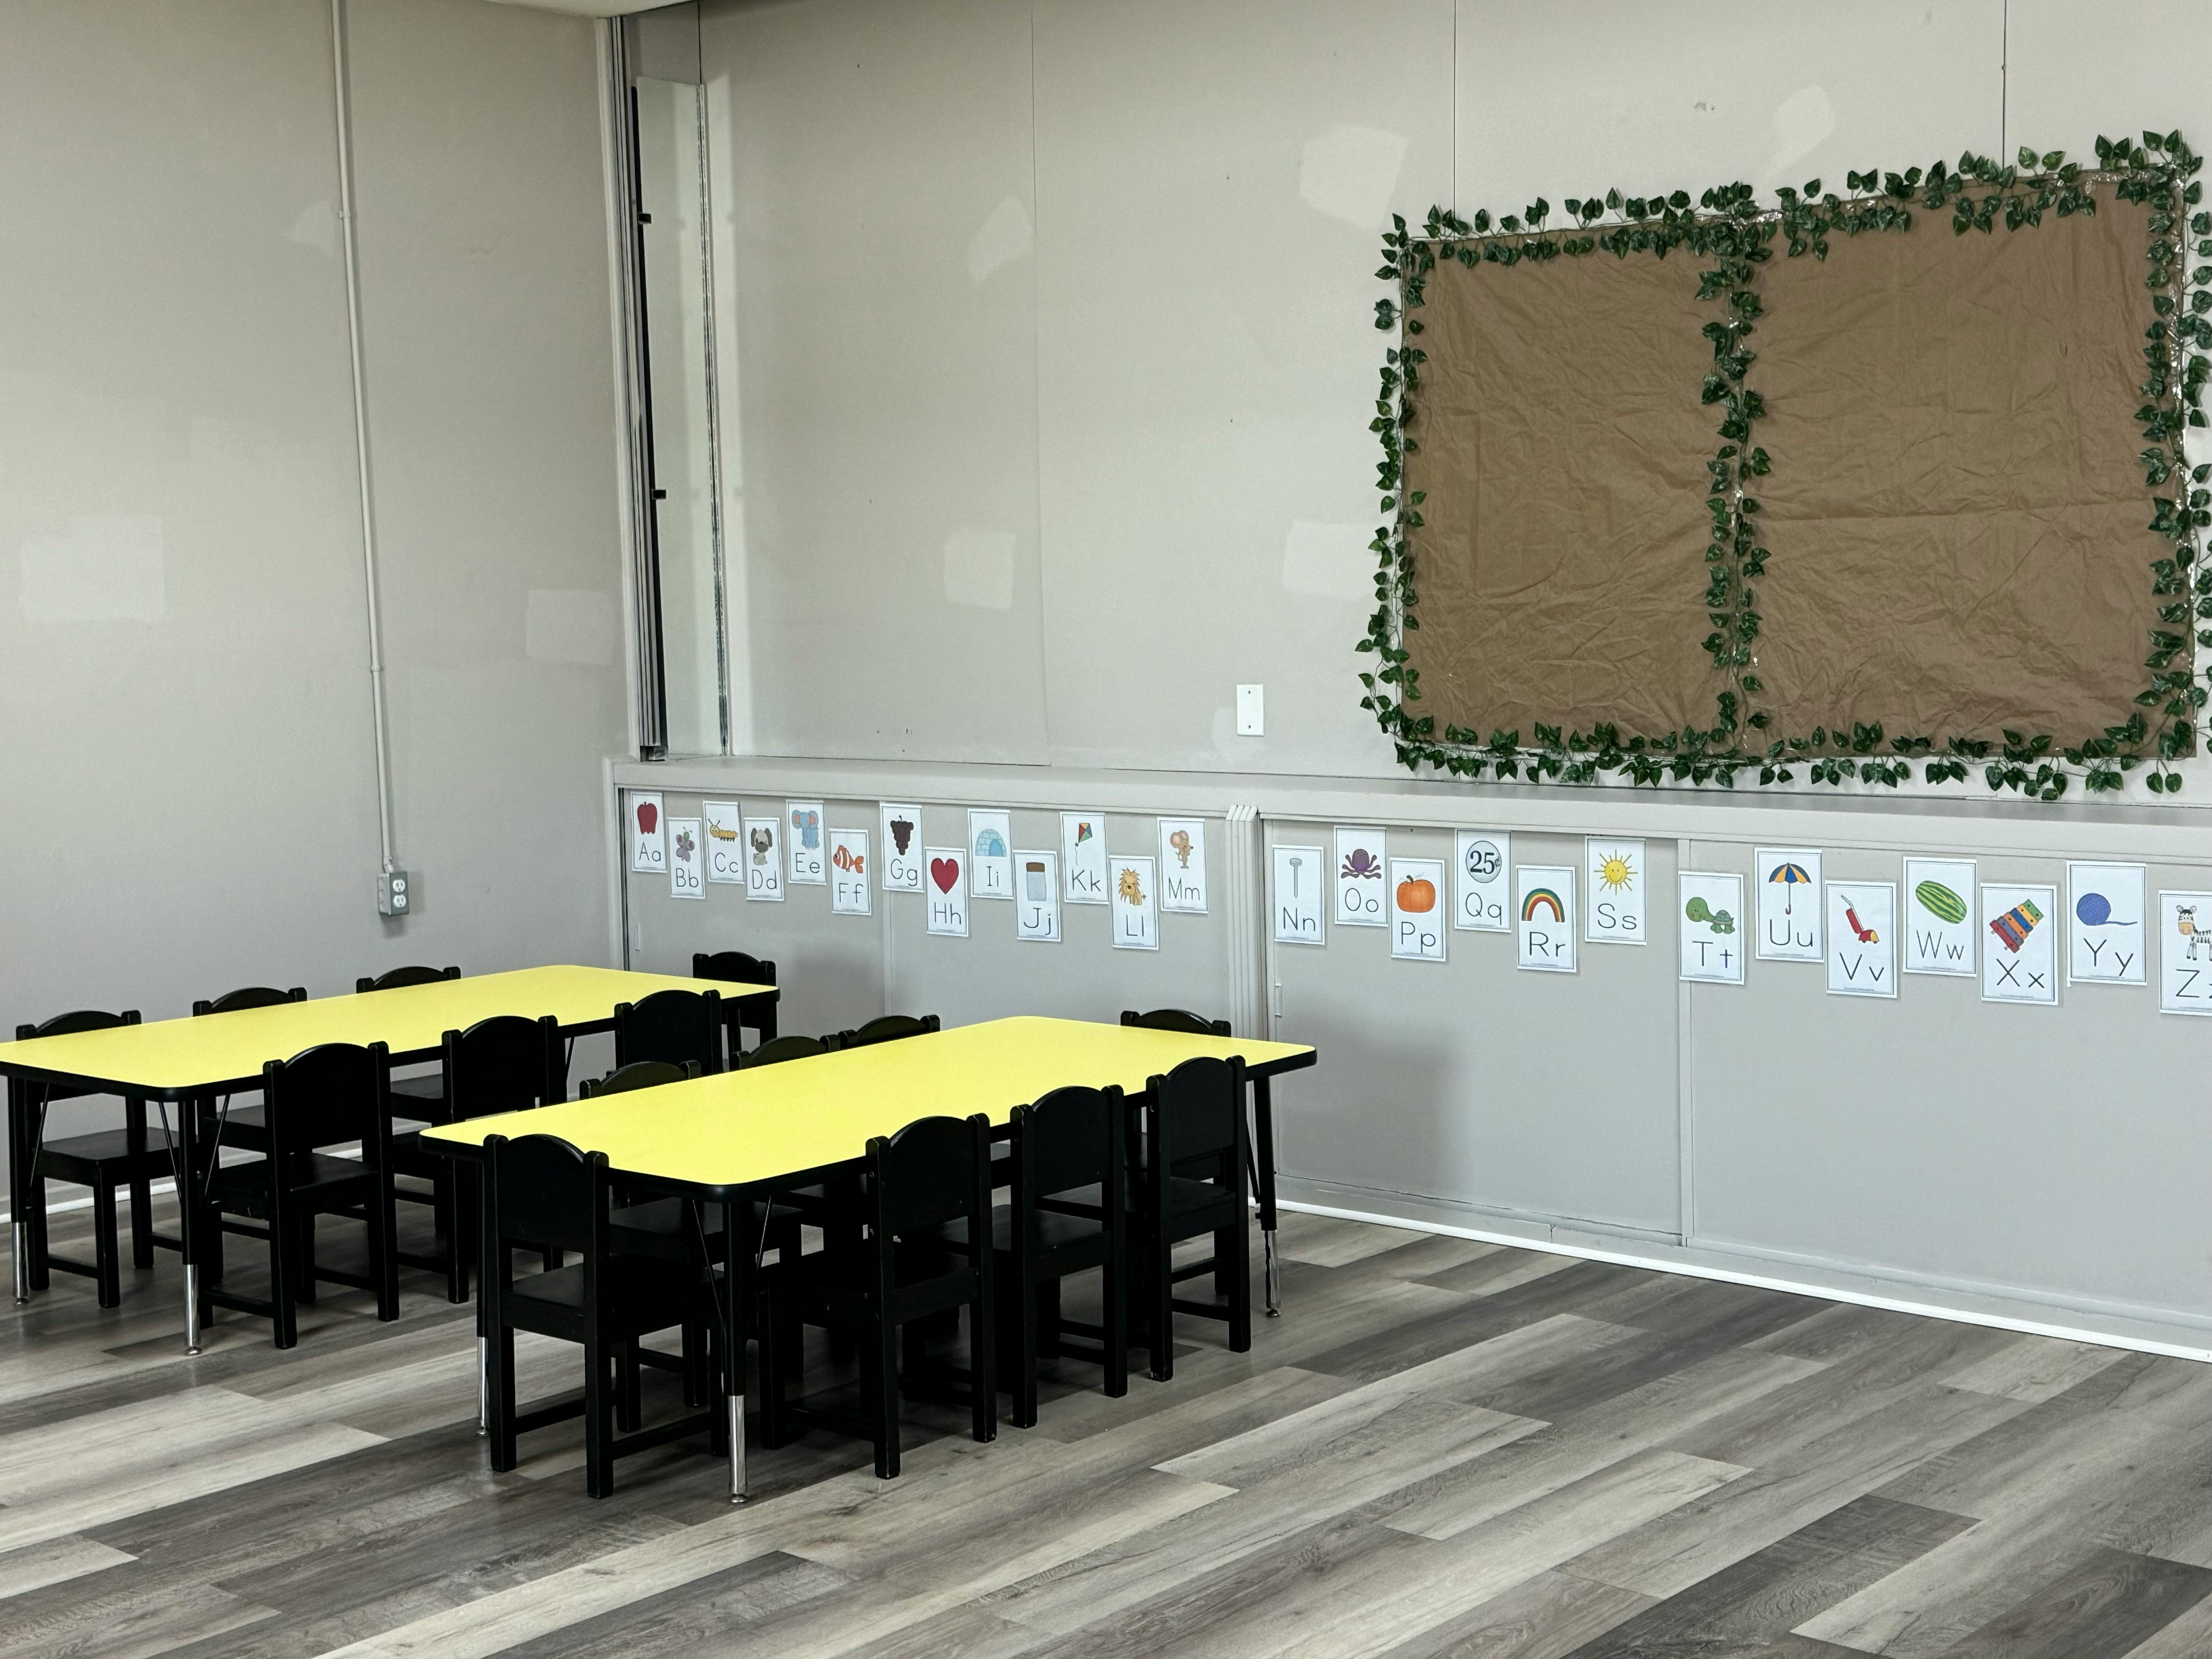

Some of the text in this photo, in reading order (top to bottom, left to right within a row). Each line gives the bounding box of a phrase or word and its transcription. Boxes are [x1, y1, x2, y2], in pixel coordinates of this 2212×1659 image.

[639, 842, 661, 862] Aa
[715, 853, 738, 872] Cc
[796, 853, 820, 873] Ee
[676, 868, 699, 888] Bb
[752, 870, 776, 889] Dd
[891, 859, 917, 886] Gg
[1072, 870, 1101, 891] Kk
[839, 883, 863, 903] Ff
[1169, 877, 1199, 900] Mm
[1345, 888, 1378, 912] Oo
[934, 902, 961, 924] Hh
[1024, 908, 1051, 935] Jj
[1284, 907, 1315, 931] Nn
[1466, 893, 1501, 925] Qq
[1598, 903, 1637, 929] Ss
[1401, 922, 1436, 953] Pp
[1530, 932, 1565, 957] Rr
[1770, 919, 1812, 947] Uu
[1917, 931, 1964, 960] Ww
[1693, 941, 1733, 968] Tt
[1840, 953, 1884, 981] Vv
[2084, 938, 2133, 976] Yy
[1997, 959, 2044, 988] Xx
[2176, 969, 2212, 998] Z
